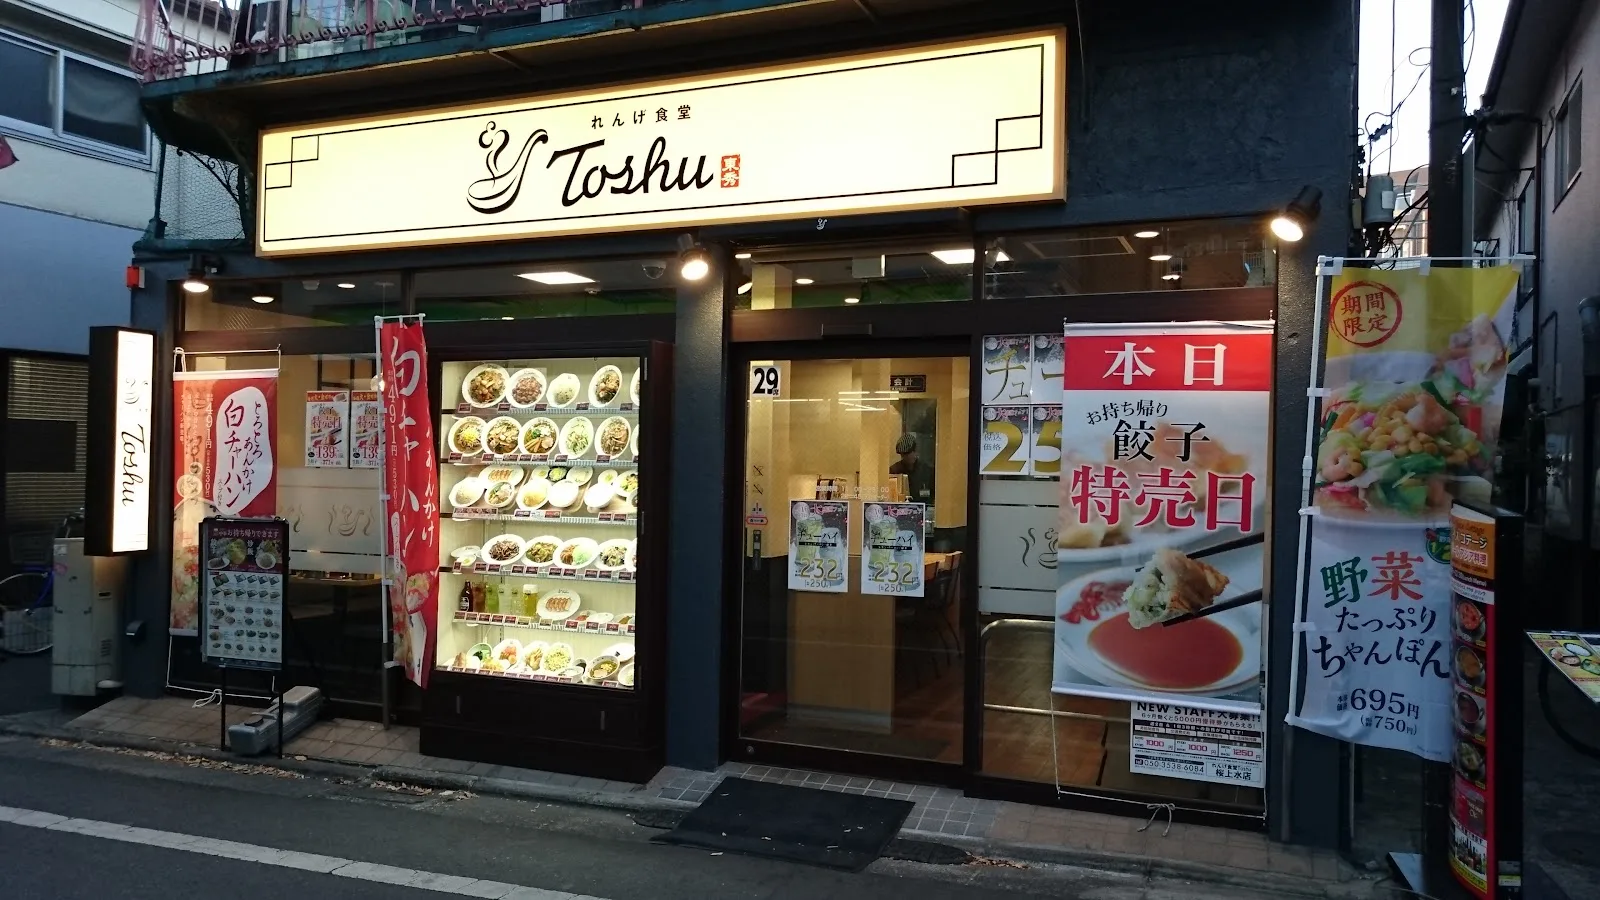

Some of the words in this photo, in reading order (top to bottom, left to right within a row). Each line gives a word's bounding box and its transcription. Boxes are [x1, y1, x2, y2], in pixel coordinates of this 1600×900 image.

[591, 104, 691, 129] れんげ食堂
[546, 136, 714, 207] Toshu
[721, 154, 740, 188] 東秀
[1341, 291, 1385, 314] 期間
[1343, 314, 1390, 336] 限定
[890, 377, 913, 387] 会計
[1102, 342, 1227, 386] 本日
[252, 401, 263, 459] とろとろ
[1086, 399, 1169, 426] お持ち帰り
[223, 398, 246, 508] 白チャーハン
[1112, 419, 1210, 462] 餃子
[121, 423, 146, 507] Toshu
[242, 436, 255, 495] あんかけ
[423, 449, 436, 548] あんかけ
[1071, 465, 1256, 532] 特売日
[1320, 551, 1424, 608] 野菜
[1336, 606, 1436, 634] たっぷり
[1312, 635, 1450, 679] ちゃんぽん
[1137, 702, 1170, 713] NEW
[1350, 687, 1420, 720] 695円
[1215, 770, 1252, 781] 桜上水店
